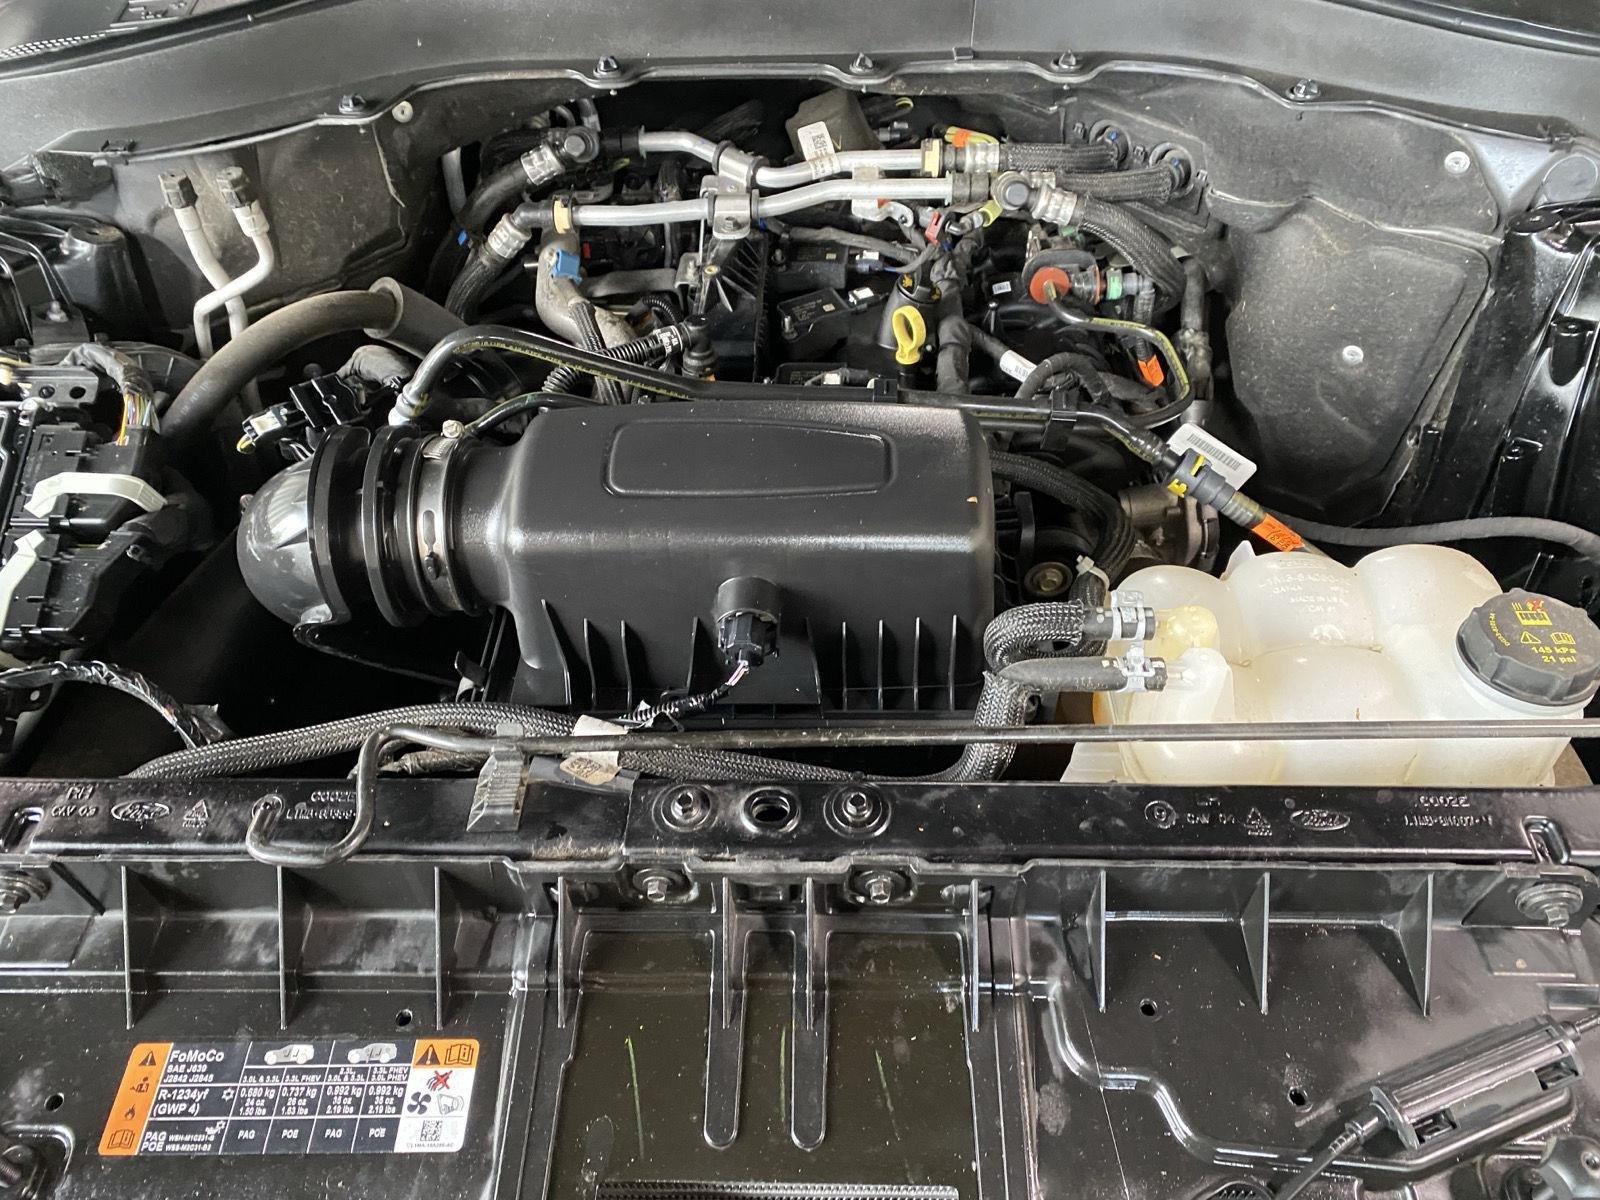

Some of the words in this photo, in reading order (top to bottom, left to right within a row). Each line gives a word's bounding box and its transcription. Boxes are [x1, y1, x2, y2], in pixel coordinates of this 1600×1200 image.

[1541, 655, 1556, 663] 21
[169, 1049, 225, 1062] FoMoCo
[166, 1064, 186, 1073] SAE
[158, 1088, 210, 1102] R-1234yf
[240, 1087, 263, 1098] 0.680
[264, 1087, 275, 1099] kg
[281, 1087, 306, 1097] 0.737
[306, 1086, 318, 1099] kg
[326, 1085, 350, 1096] 0.992
[351, 1085, 363, 1098] kg
[368, 1085, 392, 1096] 0.992
[393, 1085, 405, 1098] kg
[245, 1098, 255, 1107] 24
[255, 1098, 265, 1106] oz
[297, 1098, 307, 1106] oz
[332, 1096, 342, 1105] 35
[343, 1097, 352, 1105] oz
[374, 1096, 384, 1105] 35
[384, 1097, 394, 1105] oz
[153, 1103, 187, 1117] (GWP
[188, 1103, 200, 1117] 4)
[255, 1107, 266, 1116] lbs
[297, 1106, 309, 1115] lbs
[342, 1105, 354, 1114] lbs
[384, 1105, 396, 1114] lbs
[144, 1131, 167, 1141] PAG
[237, 1129, 256, 1140] PAG
[281, 1128, 299, 1139] POE
[324, 1128, 343, 1138] PAG
[368, 1127, 387, 1138] POE
[140, 1141, 164, 1152] POE
